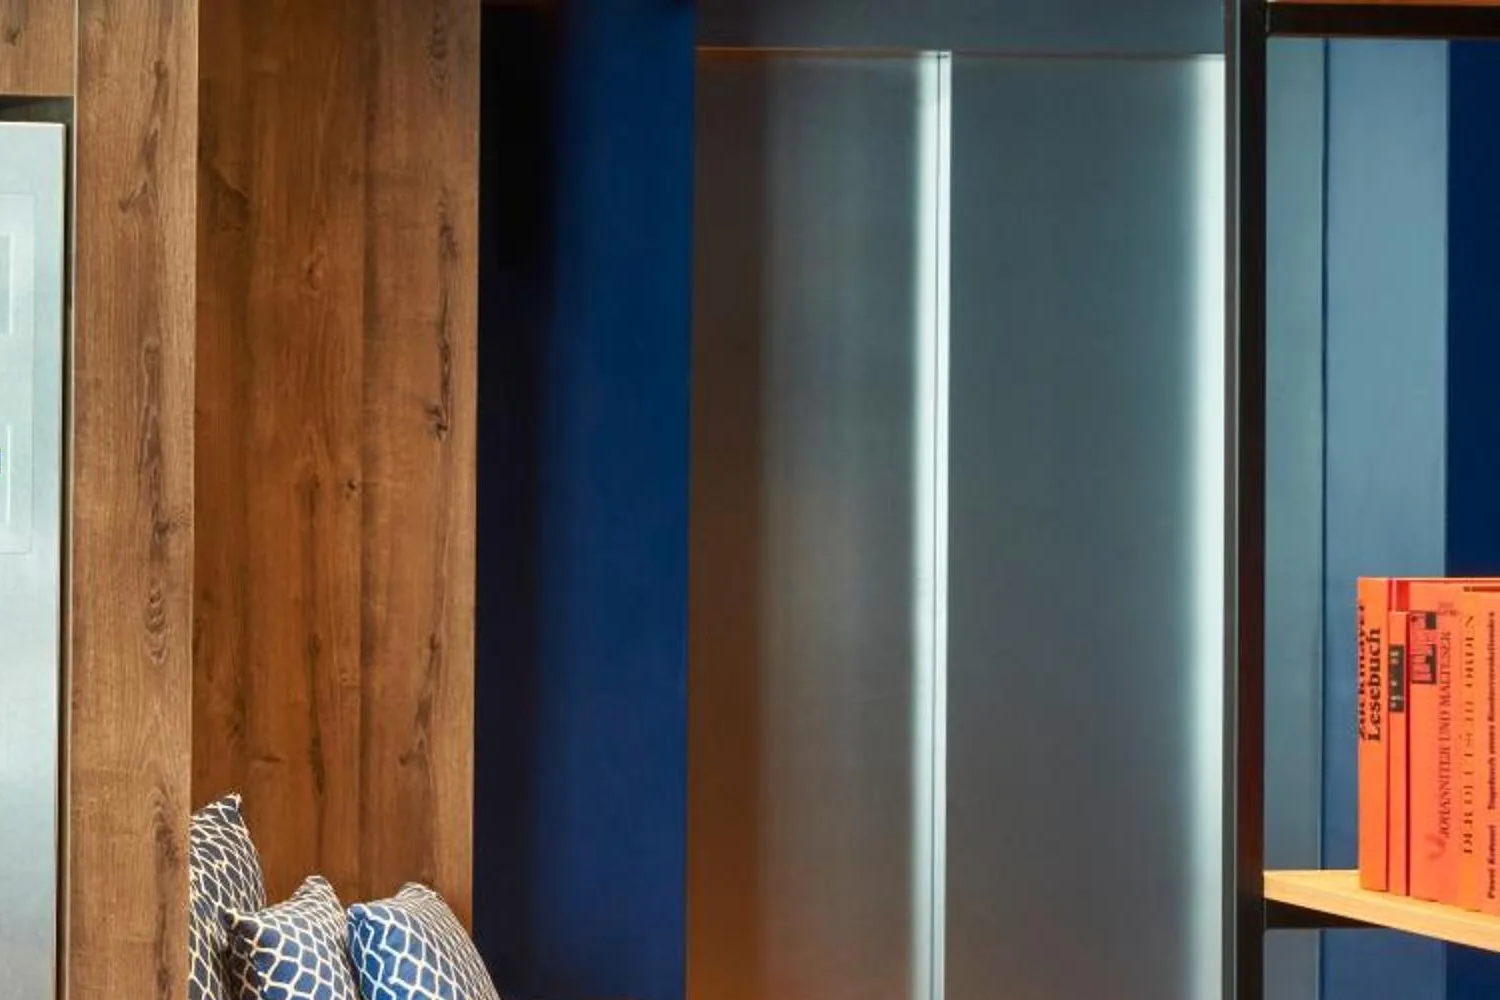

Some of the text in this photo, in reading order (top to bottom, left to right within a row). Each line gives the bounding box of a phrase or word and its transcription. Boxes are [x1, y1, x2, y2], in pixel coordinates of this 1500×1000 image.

[1366, 628, 1381, 742] Lesebuch
[1438, 632, 1451, 838] JOHANNITER UND MALTESER
